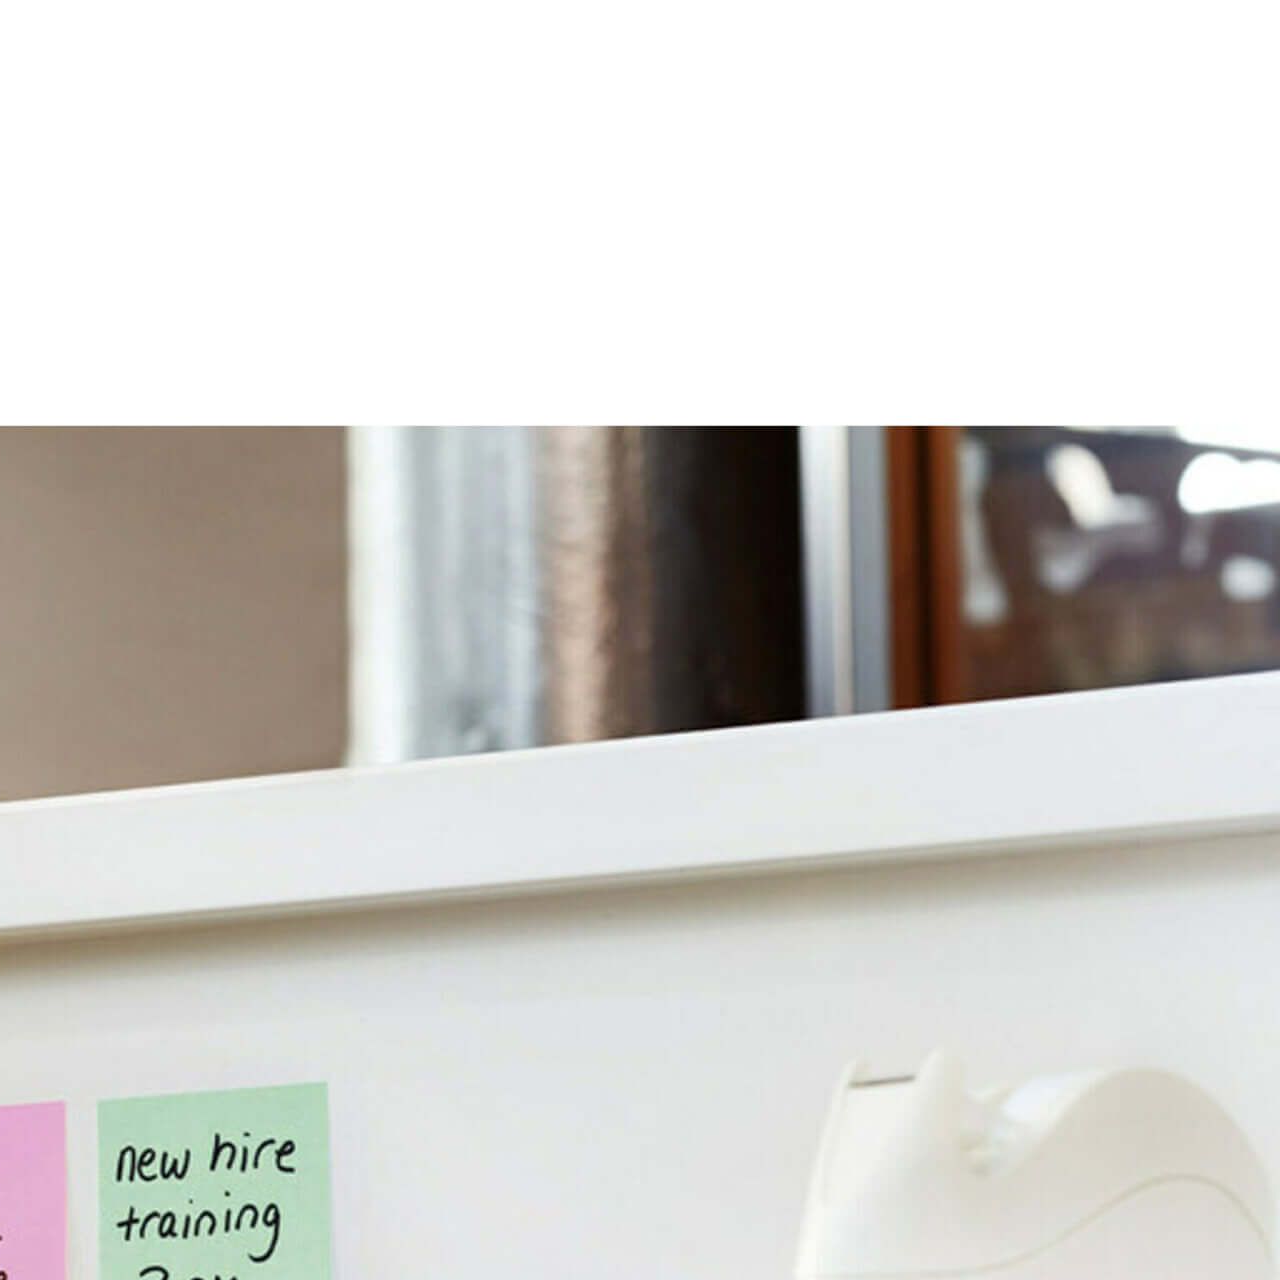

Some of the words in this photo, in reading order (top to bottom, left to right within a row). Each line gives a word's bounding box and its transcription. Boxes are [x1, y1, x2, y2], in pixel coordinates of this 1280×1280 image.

[114, 1144, 192, 1184] new
[208, 1131, 297, 1174] hire
[115, 1190, 282, 1265] training
